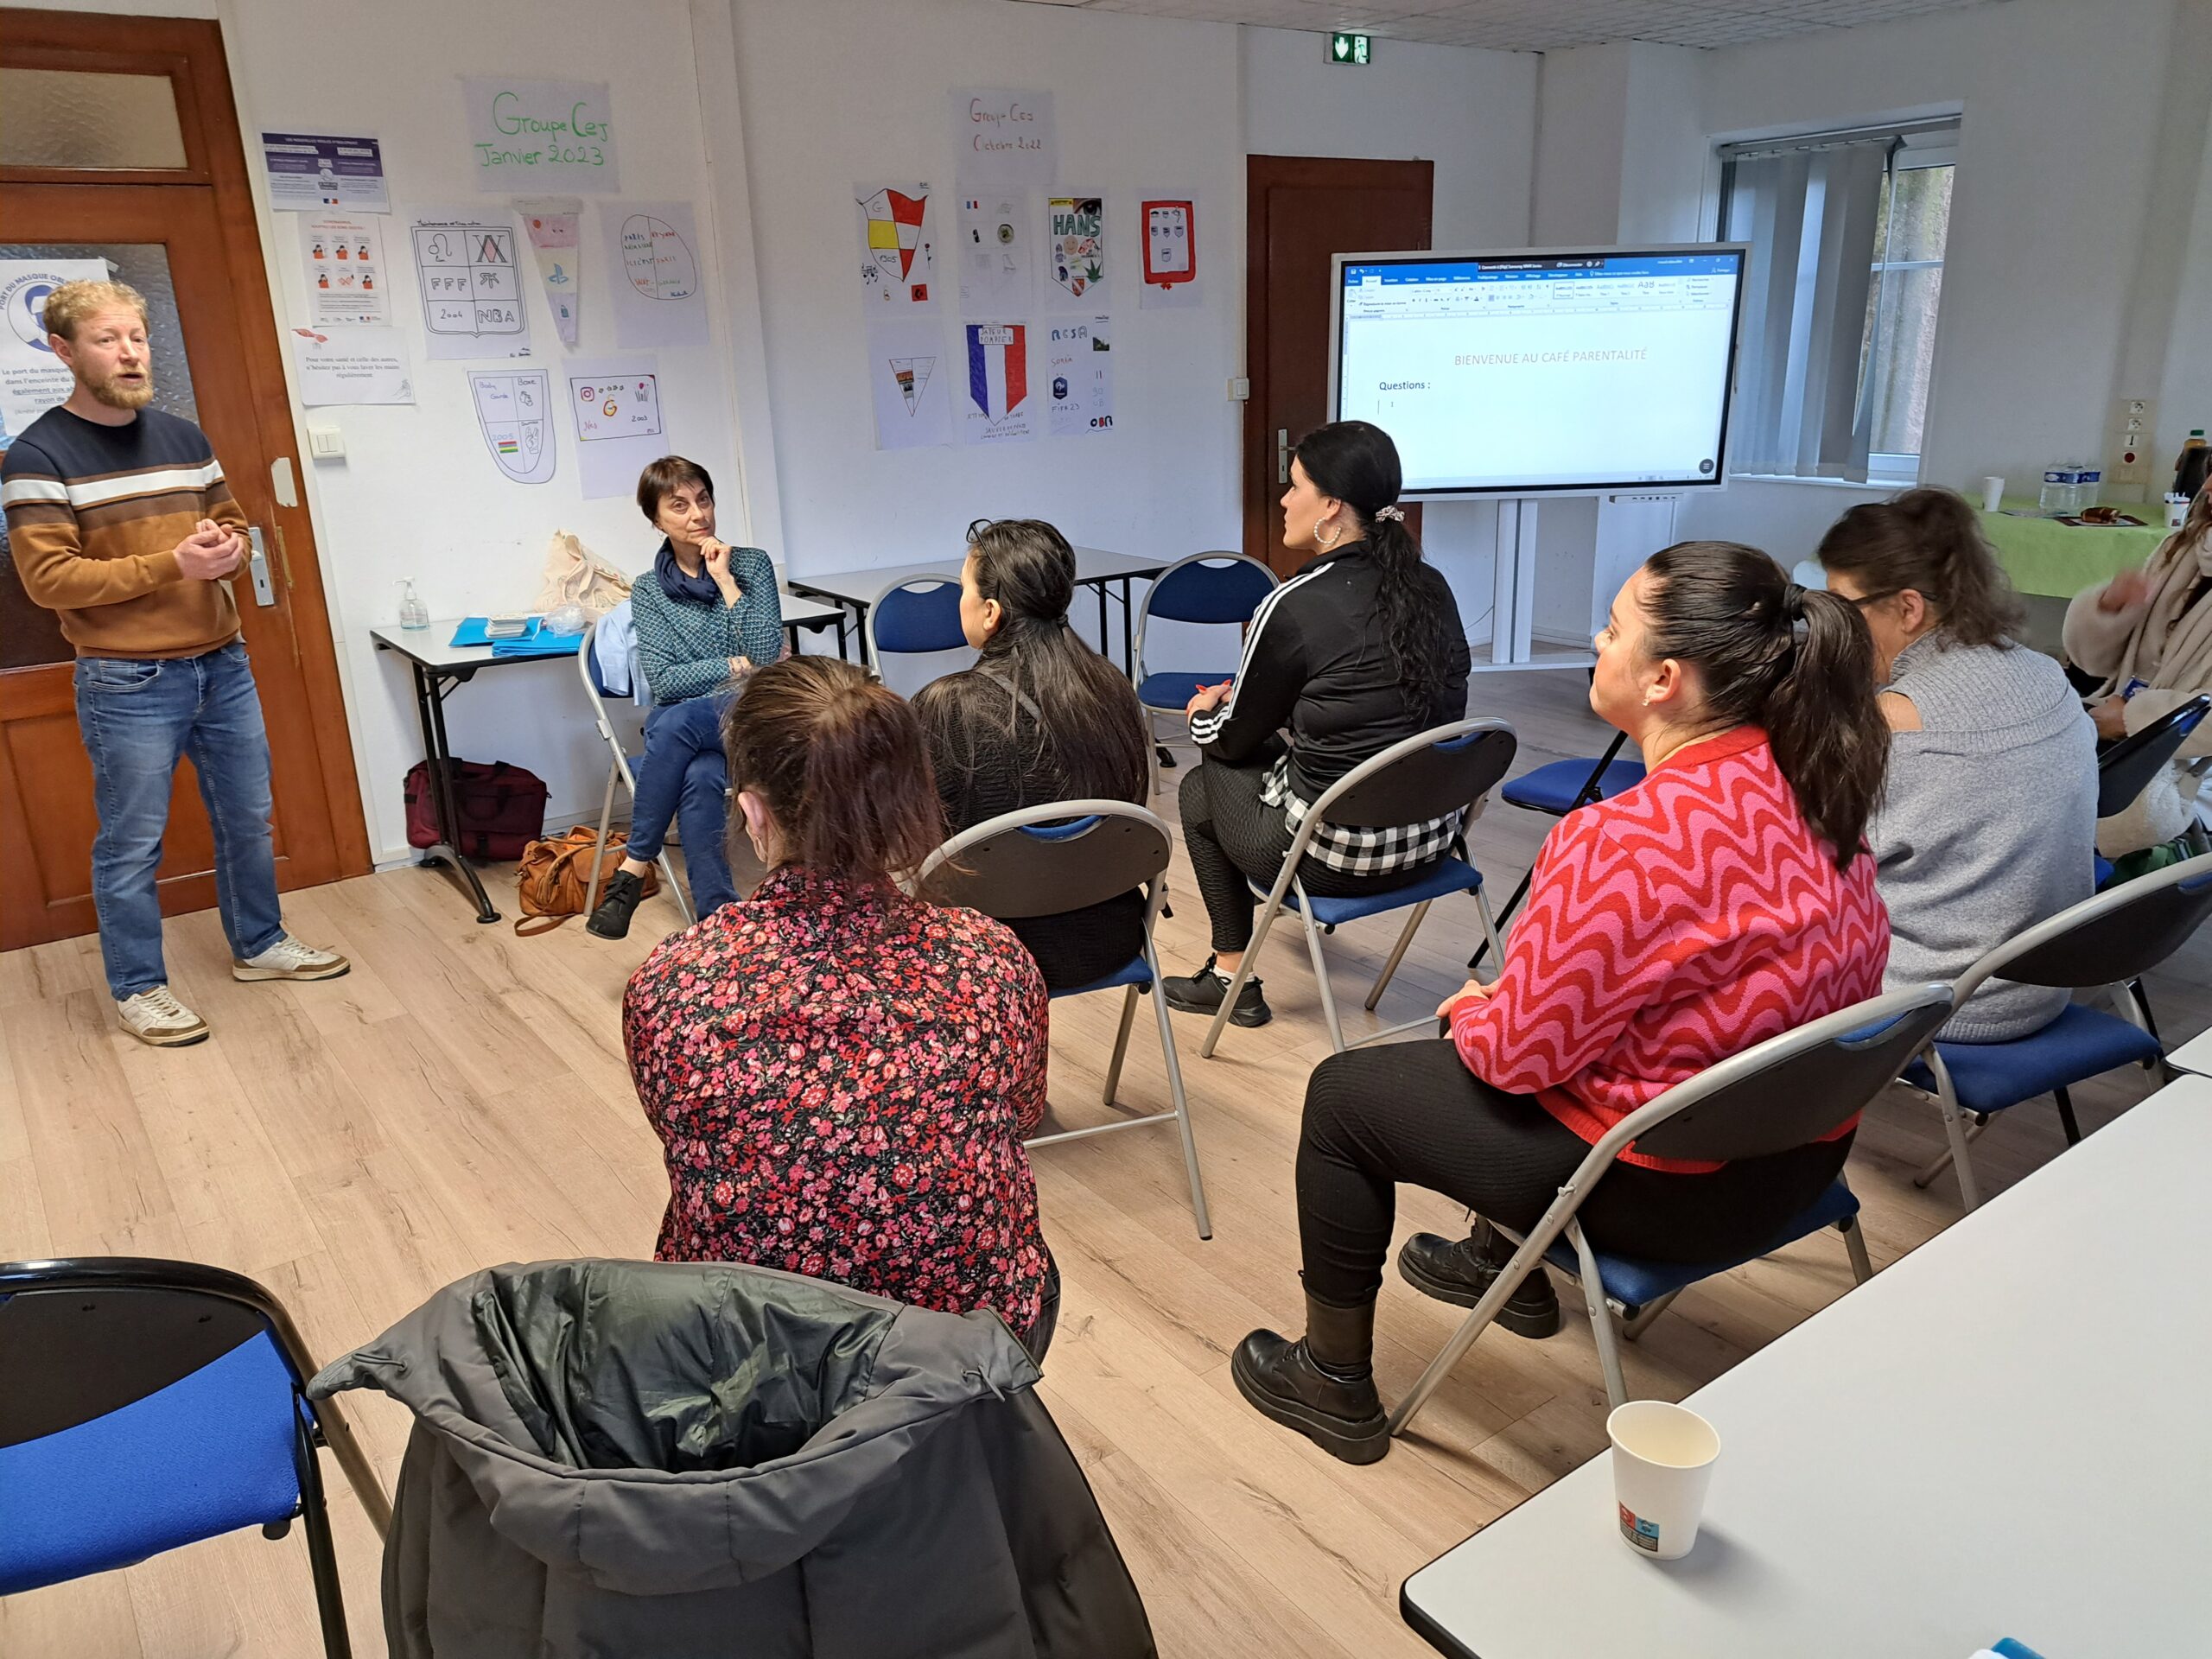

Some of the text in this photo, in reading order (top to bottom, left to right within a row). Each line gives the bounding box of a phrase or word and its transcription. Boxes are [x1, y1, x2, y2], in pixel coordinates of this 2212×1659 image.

[493, 92, 567, 142] Groupe
[474, 143, 604, 167] Janvier 2023
[1053, 214, 1101, 238] HANS
[6, 281, 16, 293] DU
[15, 273, 49, 286] MASQUE
[441, 308, 463, 319] 2004
[477, 309, 515, 323] NBA
[1454, 346, 1647, 366] BIENVENUE AU CAFÉ PARENTALITÉ
[1379, 380, 1426, 391] Questions
